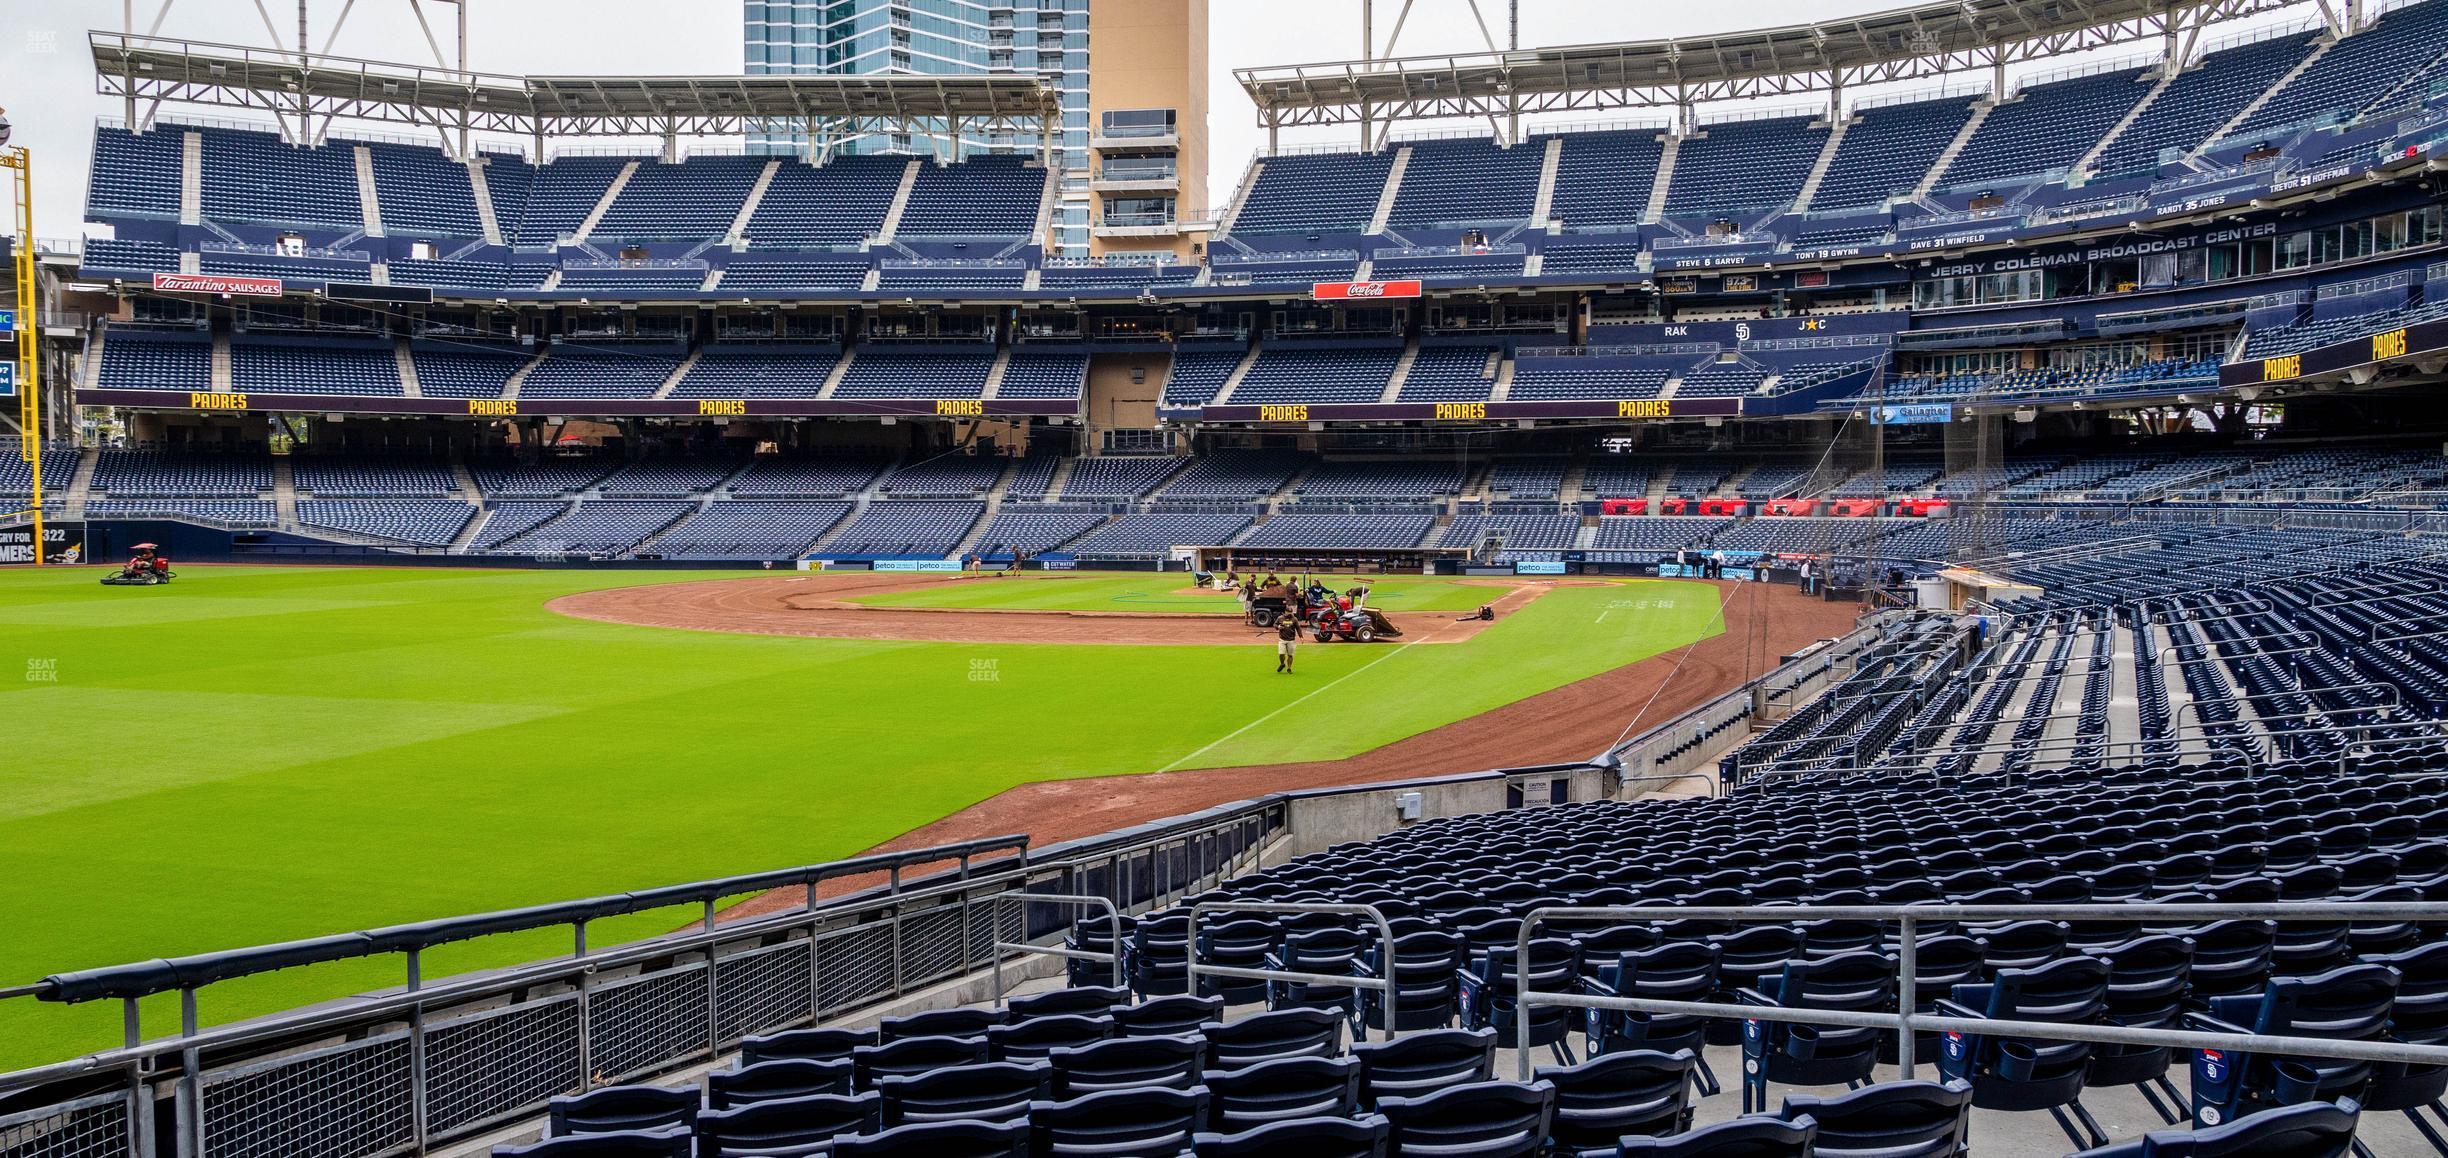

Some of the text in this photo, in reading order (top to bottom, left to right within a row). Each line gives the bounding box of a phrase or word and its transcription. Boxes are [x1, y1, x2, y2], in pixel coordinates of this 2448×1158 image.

[2405, 144, 2418, 158] 42
[2270, 167, 2350, 194] TREVOR 51 HOFFMAN
[2156, 196, 2226, 216] RANDY 35 JONES
[1911, 234, 1985, 250] DAVE 31 WINFIELD
[1931, 222, 2277, 278] JERRY COLEMAN BROADCAST CENTER
[1676, 256, 1746, 268] STEVE 6 GARVEY
[1795, 248, 1859, 260] TONY 19 GWYNN
[157, 275, 280, 295] Tarantino SAUSAGES
[1665, 326, 1688, 337] RAK
[2372, 327, 2406, 361] PADRES
[2263, 354, 2301, 382] PADRES
[191, 392, 247, 410] PADRES
[469, 399, 517, 415] PADRES
[700, 400, 745, 415] PADRES
[937, 400, 983, 415] PADRES
[1618, 400, 1670, 417] PADRES
[1261, 405, 1308, 421] PADRES
[1436, 403, 1485, 419] PADRES
[1899, 406, 1949, 417] Gallagher
[14, 532, 31, 543] FOR
[42, 529, 66, 542] 322
[1518, 564, 1541, 572] petco
